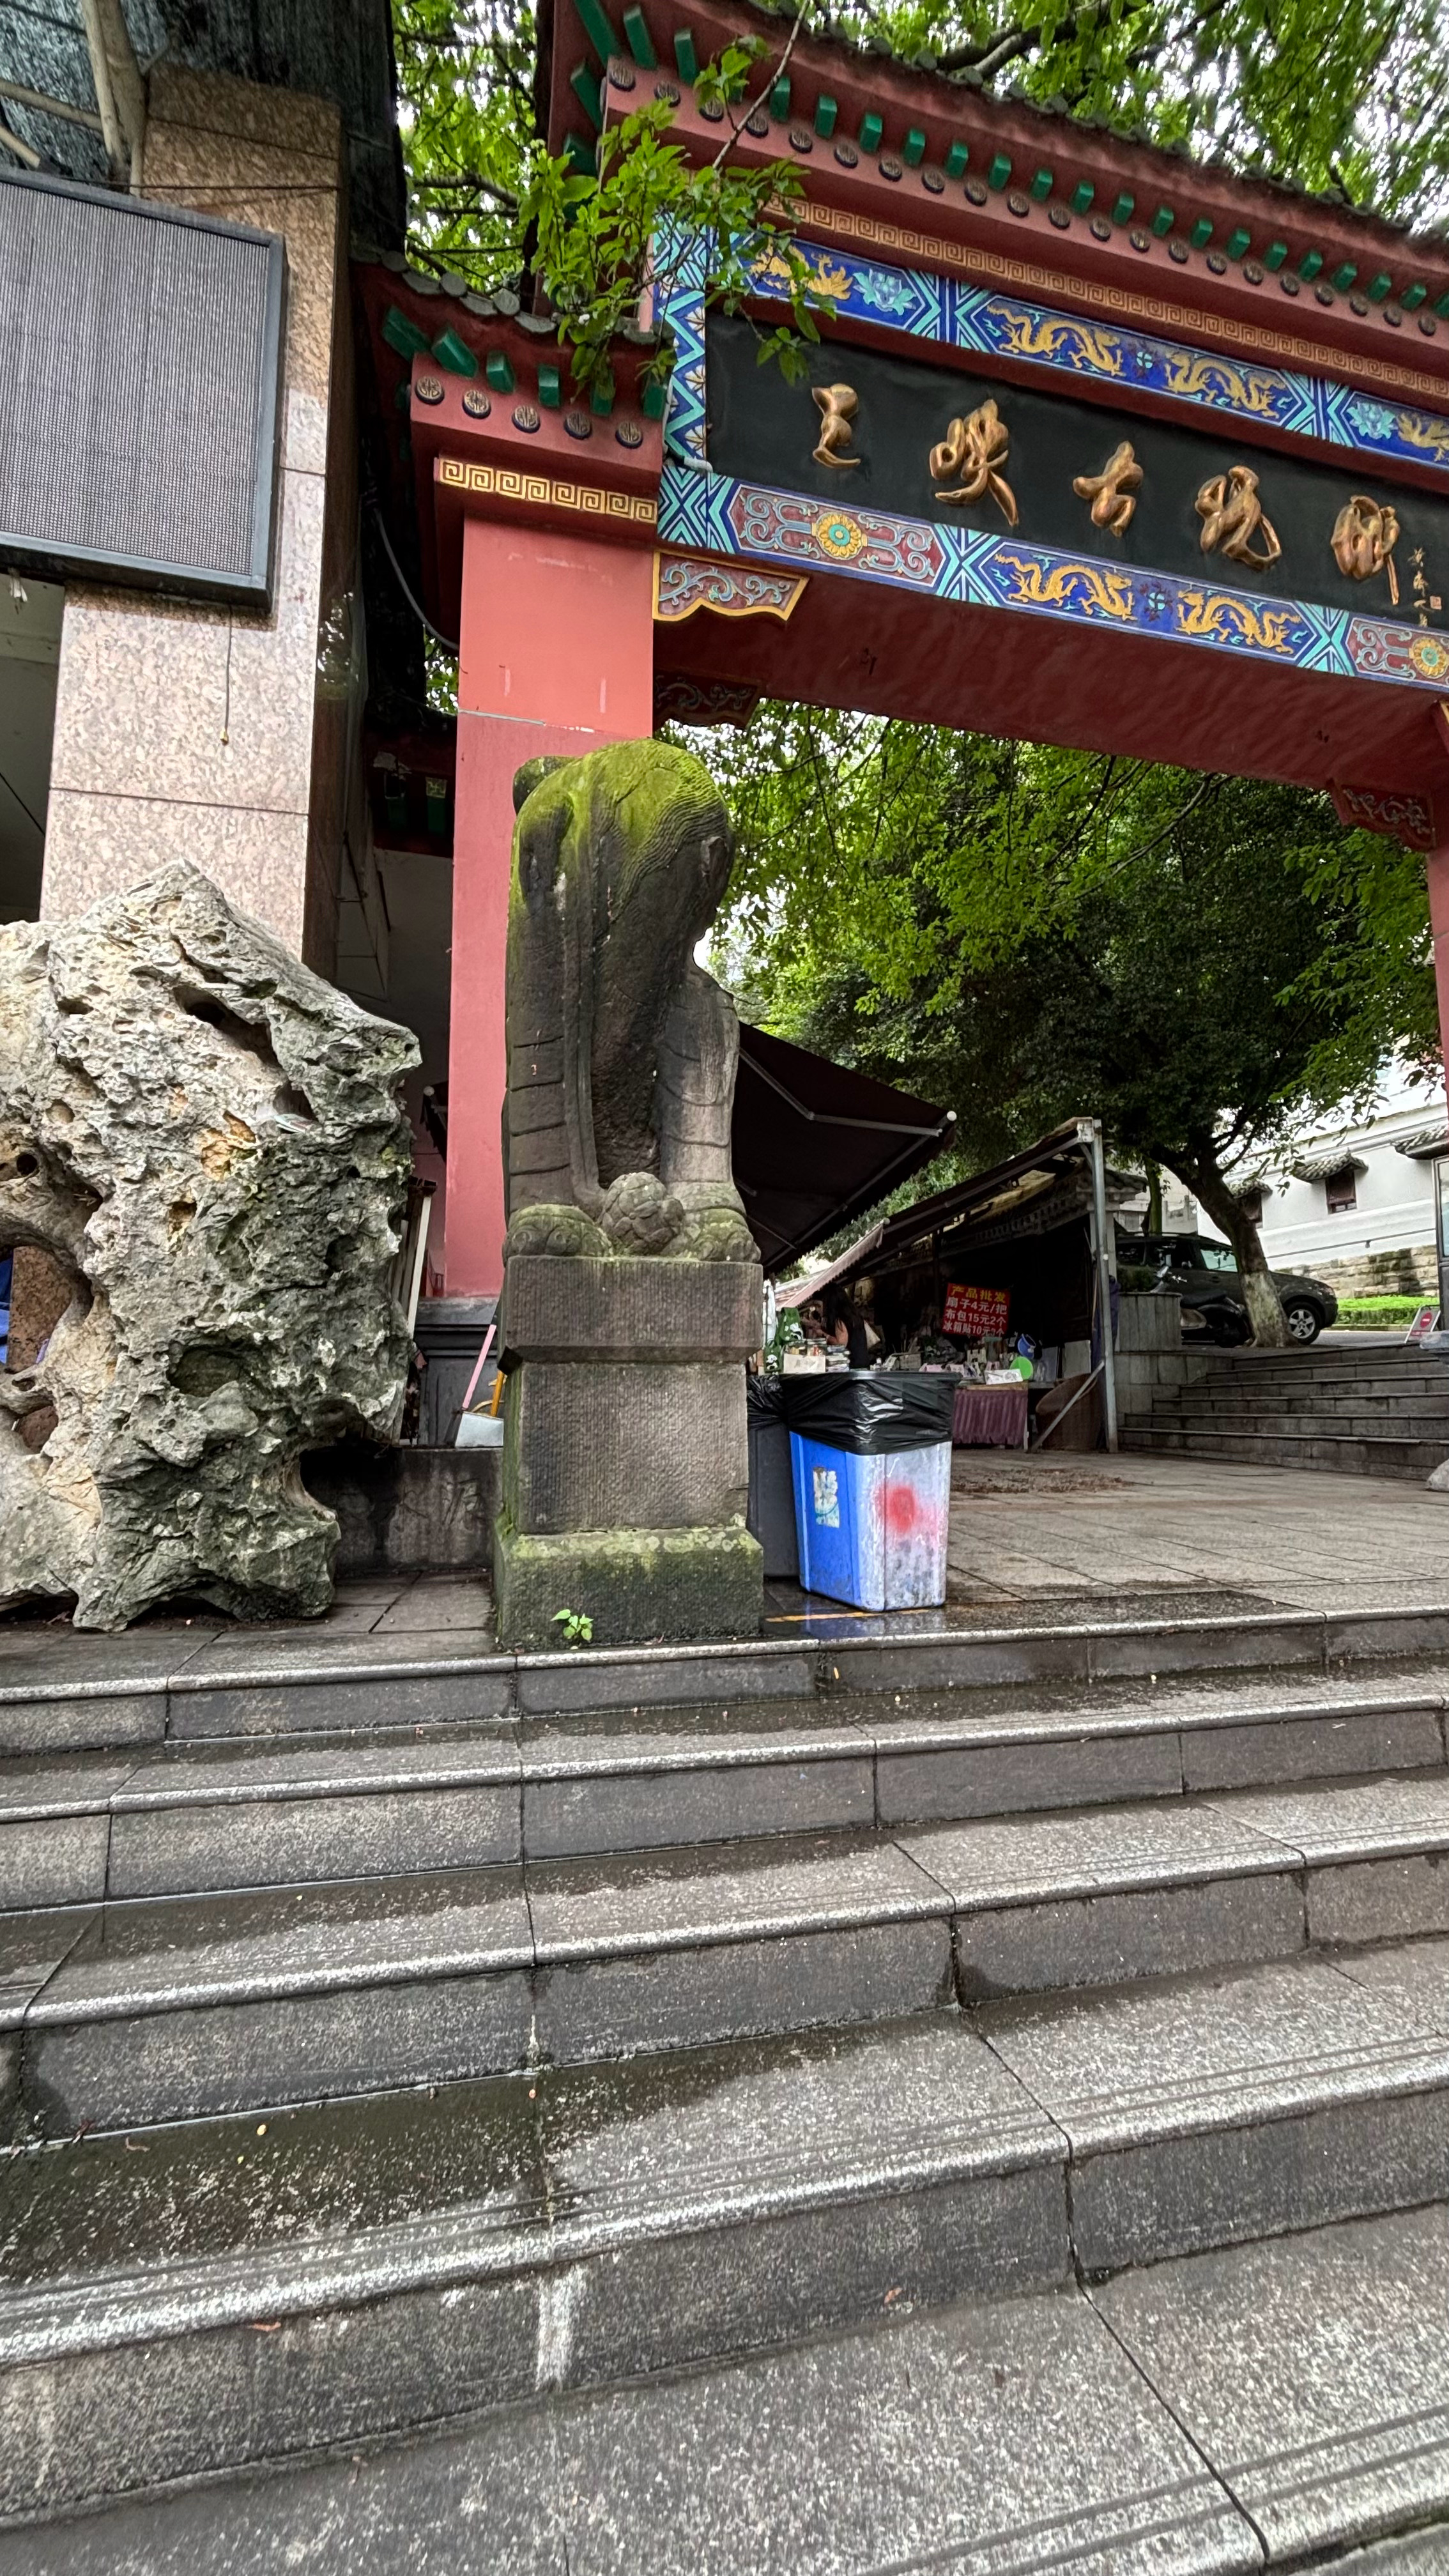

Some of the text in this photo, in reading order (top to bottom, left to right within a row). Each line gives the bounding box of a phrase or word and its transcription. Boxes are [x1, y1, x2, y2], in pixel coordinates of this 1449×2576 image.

[951, 1286, 1006, 1303] 产品批发
[946, 1297, 1007, 1314] 扇子4元/把
[946, 1309, 1006, 1326] 布包15元2个
